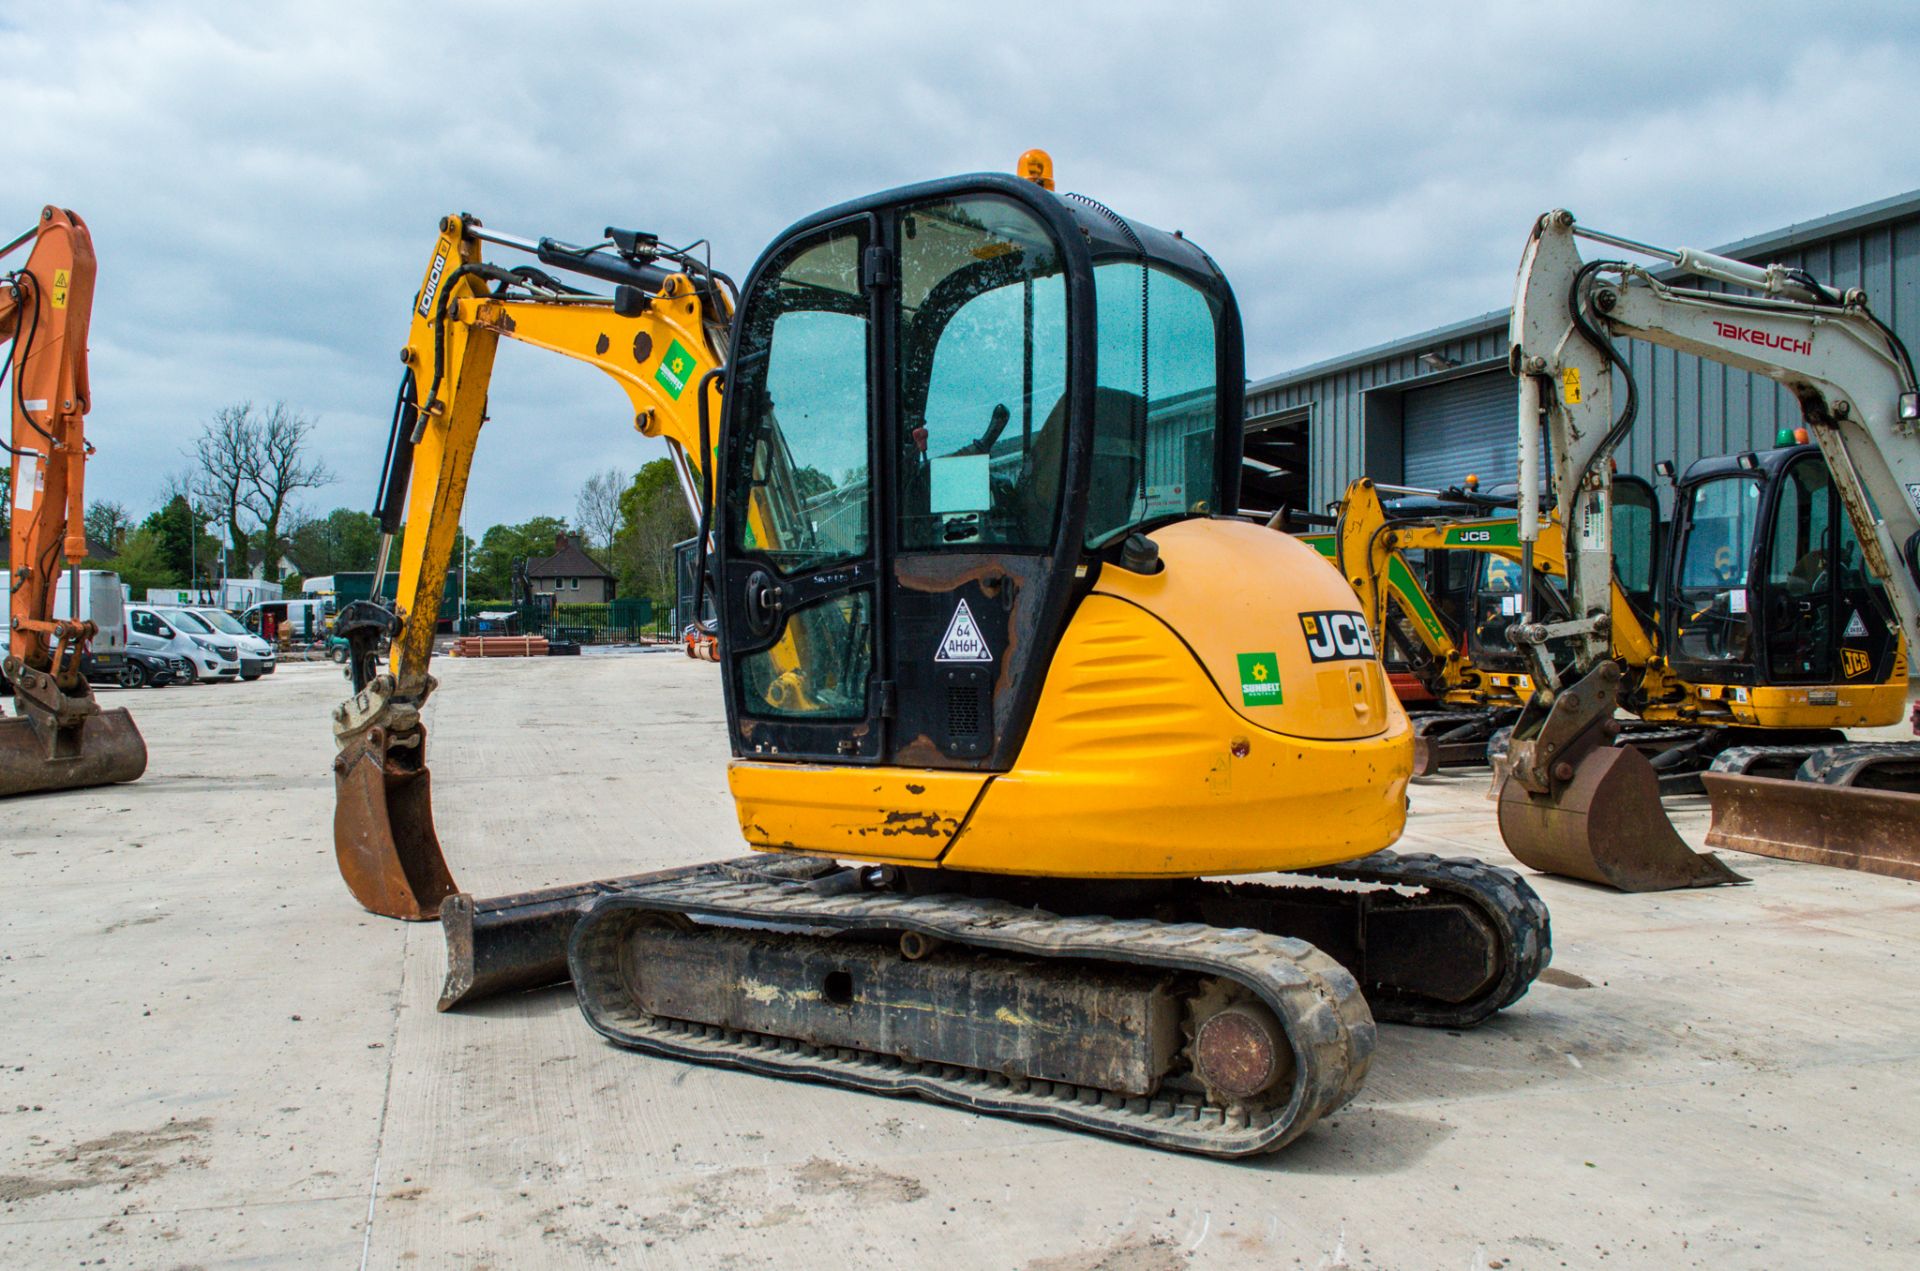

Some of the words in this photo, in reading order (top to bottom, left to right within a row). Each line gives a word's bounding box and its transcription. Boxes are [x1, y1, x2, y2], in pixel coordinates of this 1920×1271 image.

[421, 254, 445, 310] 8050
[1460, 531, 1490, 541] JCB
[956, 624, 970, 637] 64
[1308, 614, 1375, 658] JCB
[948, 639, 978, 652] AH6H
[1845, 651, 1868, 675] JCB
[1242, 683, 1280, 692] SUNBELT
